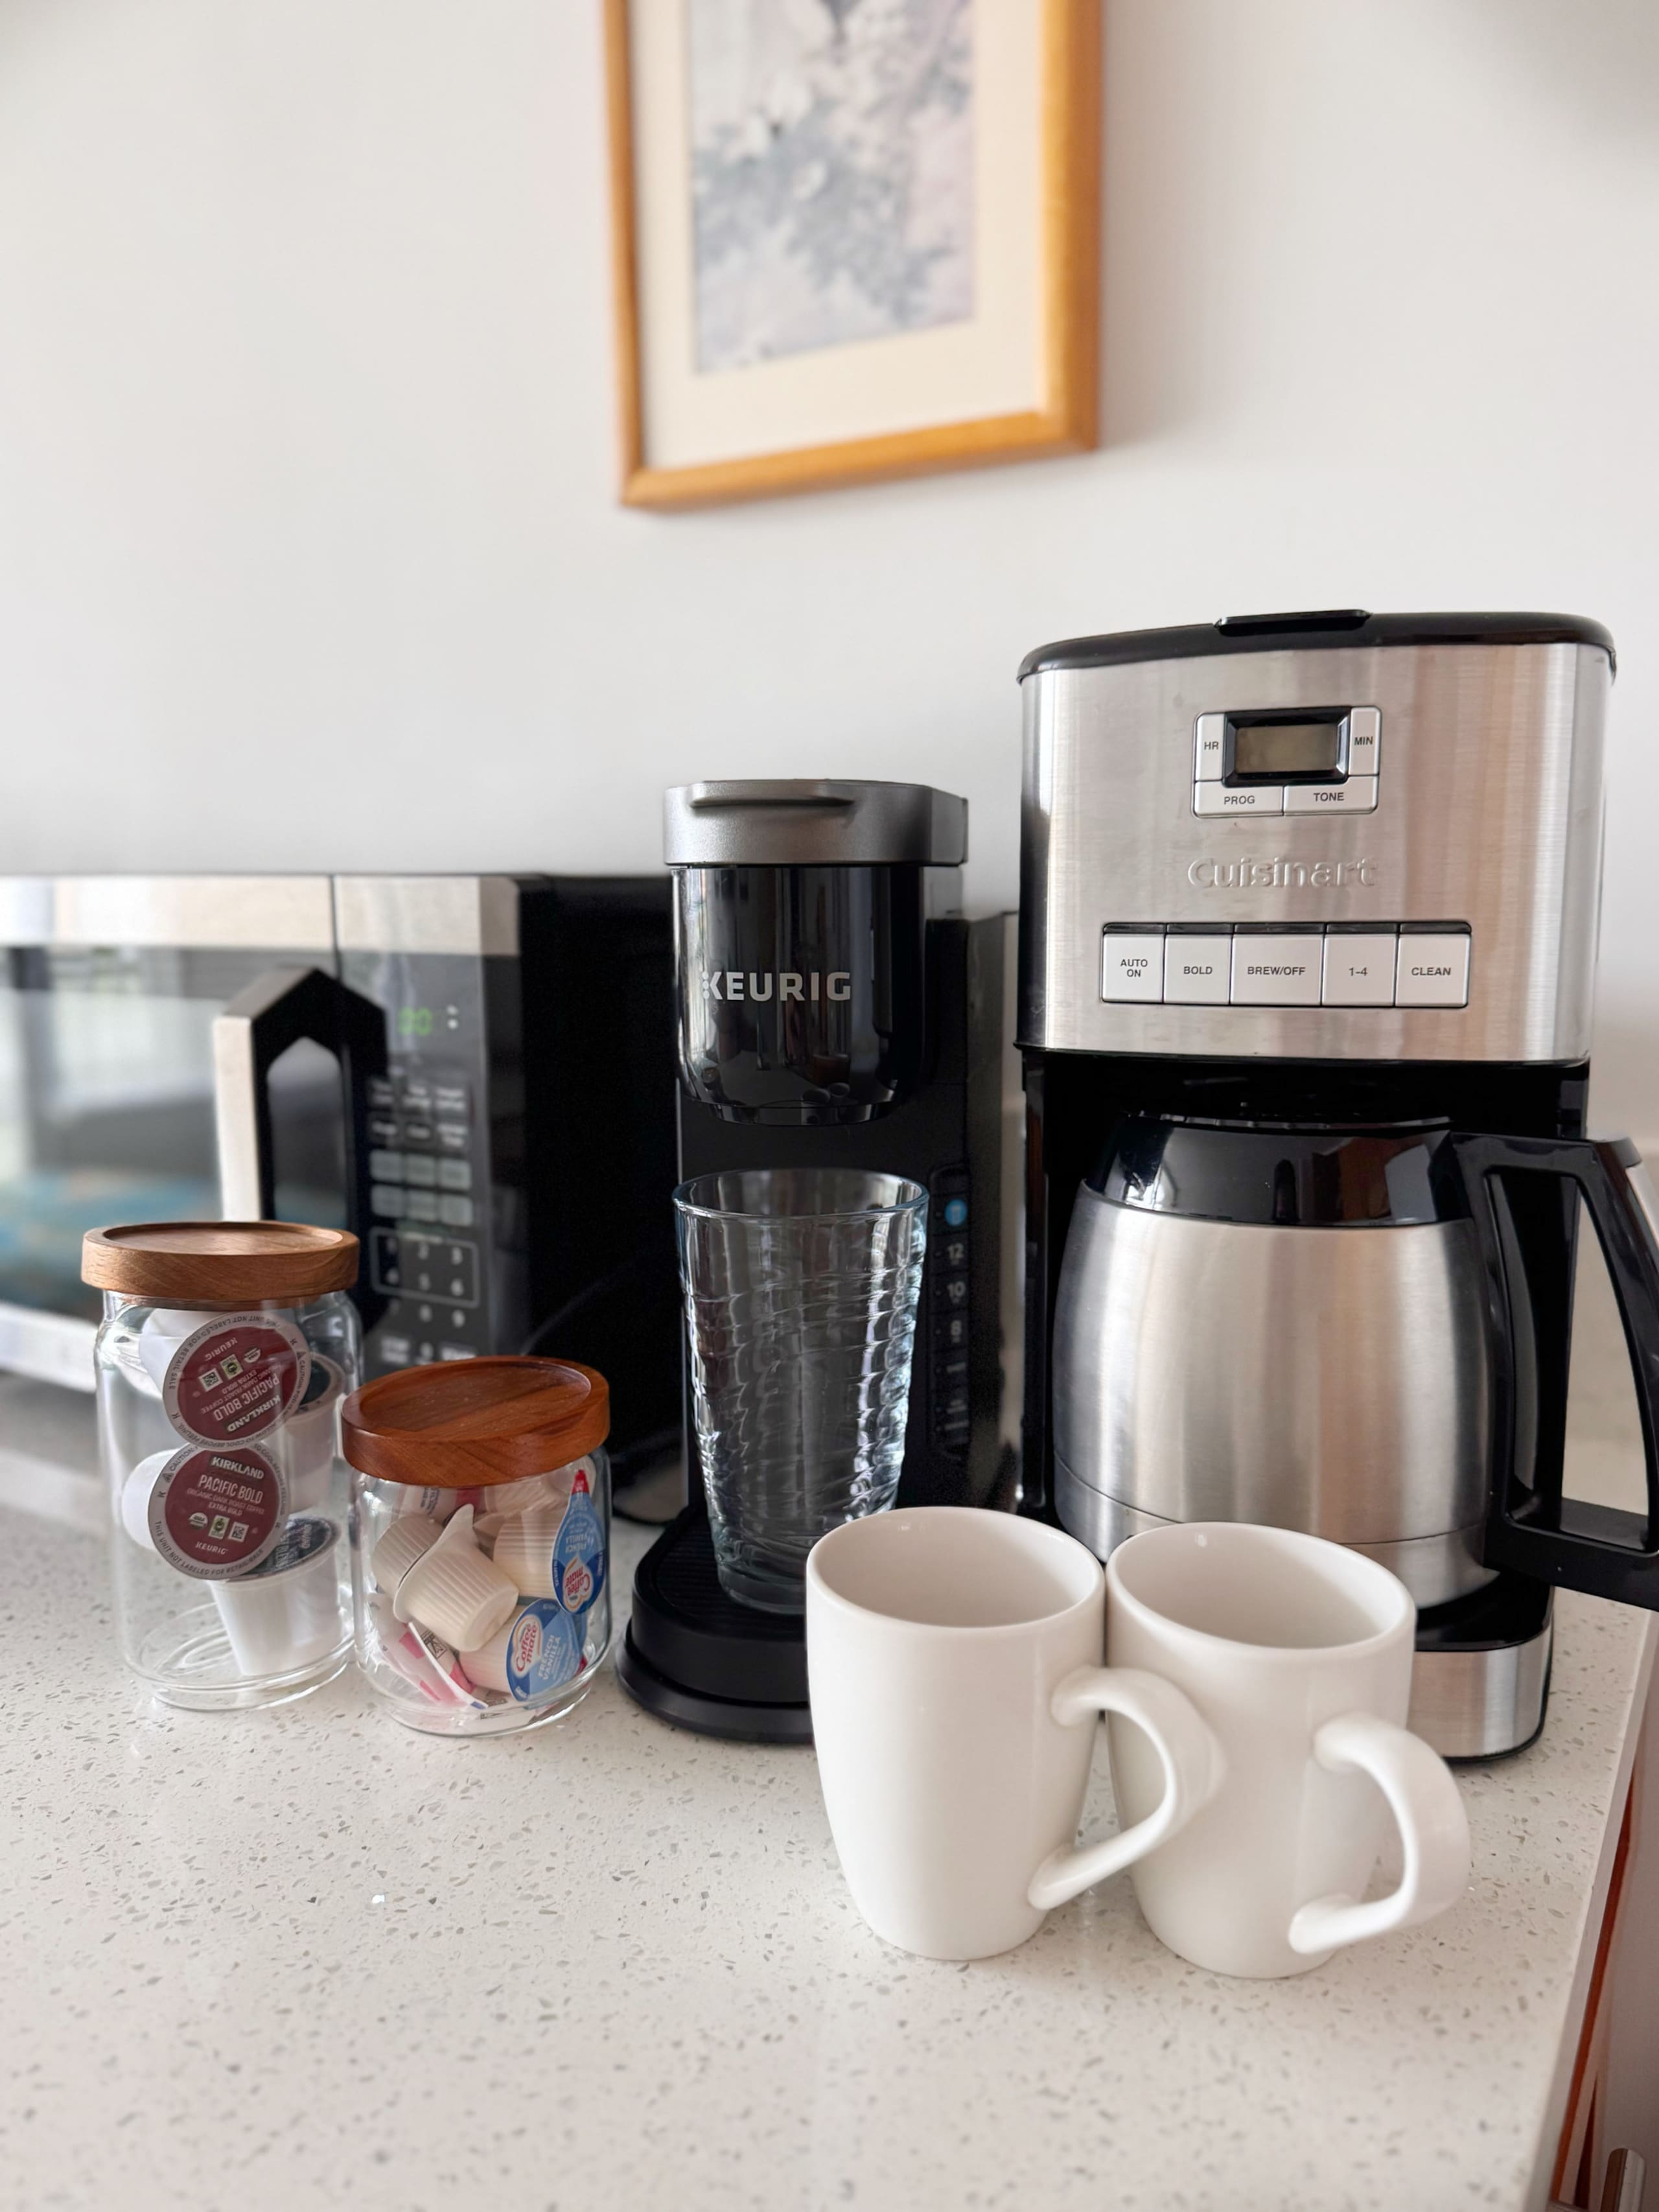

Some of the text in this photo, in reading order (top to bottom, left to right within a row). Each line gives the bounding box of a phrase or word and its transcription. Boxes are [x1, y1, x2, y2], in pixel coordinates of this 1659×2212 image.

[1204, 741, 1219, 751] HR
[1354, 736, 1373, 746] MIN
[1224, 795, 1256, 805] PROG
[1313, 792, 1345, 802] TONE
[1187, 856, 1378, 887] Cuisinart
[1120, 959, 1148, 968] AUTO
[1183, 966, 1212, 975] BOLD
[1247, 966, 1306, 976] BREW/OFF
[1411, 966, 1452, 976] CLEAN
[1126, 969, 1141, 978] ON
[1349, 968, 1368, 977] 1-4
[702, 971, 852, 1001] KEURIG
[947, 1242, 964, 1259] 12
[947, 1281, 966, 1295] 10
[950, 1320, 962, 1336] 8
[205, 1337, 238, 1361] KEURIG
[168, 1373, 178, 1390] SALE
[241, 1373, 280, 1404] PACIFIC
[213, 1398, 242, 1421] BOLD
[227, 1395, 281, 1432] KIRKLAND
[212, 1456, 264, 1480] KIRKLAND
[198, 1474, 264, 1504] PACIFIC BOLD
[155, 1520, 164, 1537] THIS
[159, 1537, 172, 1553] UNIT
[195, 1541, 229, 1555] KEURIG
[168, 1552, 182, 1563] NOT
[181, 1561, 210, 1575] LABELED
[565, 1565, 584, 1589] mate
[566, 1574, 590, 1596] Coffee
[516, 1624, 531, 1672] Coffee
[526, 1623, 538, 1664] mate
[539, 1635, 555, 1677] FRENCH
[542, 1636, 561, 1680] VANILLA
